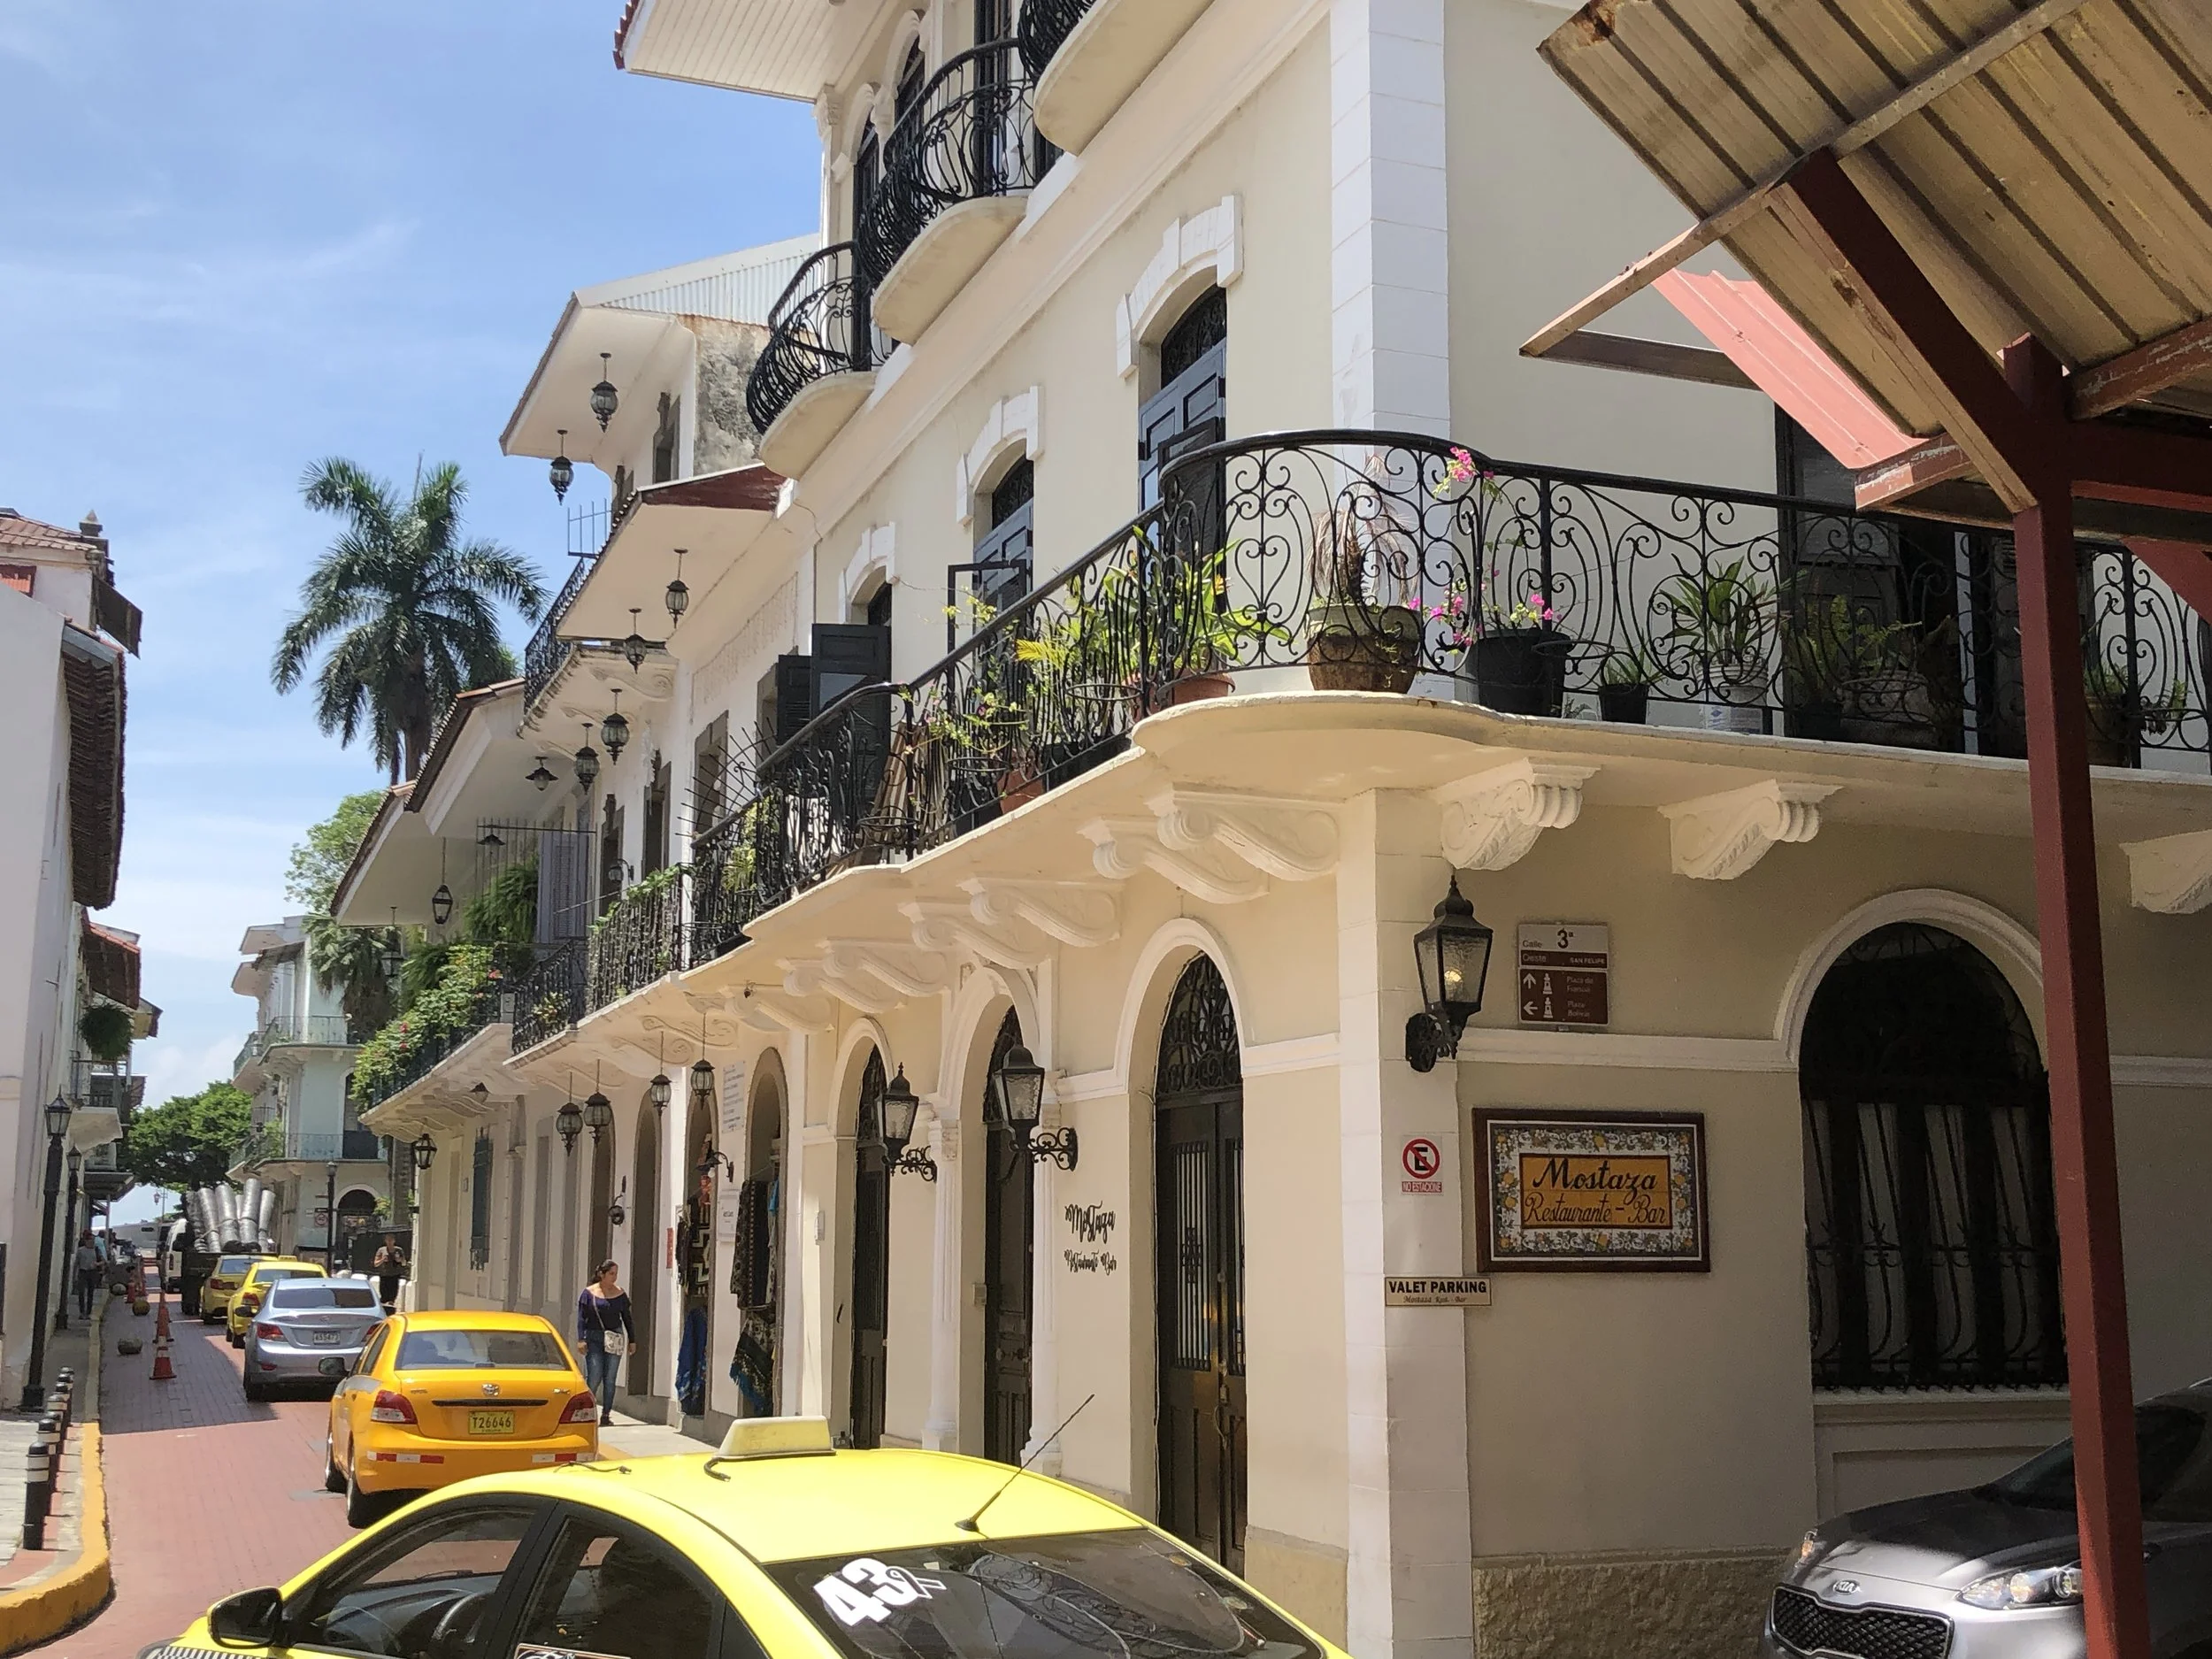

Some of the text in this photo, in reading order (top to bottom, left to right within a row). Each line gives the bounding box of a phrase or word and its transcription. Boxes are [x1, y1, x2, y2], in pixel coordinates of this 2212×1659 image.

[1522, 953, 1548, 963] Oeste
[1402, 1181, 1441, 1193] NO ESTACIONE
[1532, 1157, 1657, 1205] Mostaza
[1524, 1192, 1611, 1223] Restaurante
[1627, 1195, 1666, 1225] Bar
[1388, 1280, 1486, 1294] VALET PARKING
[472, 1417, 511, 1429] T26646
[812, 1557, 918, 1626] 43
